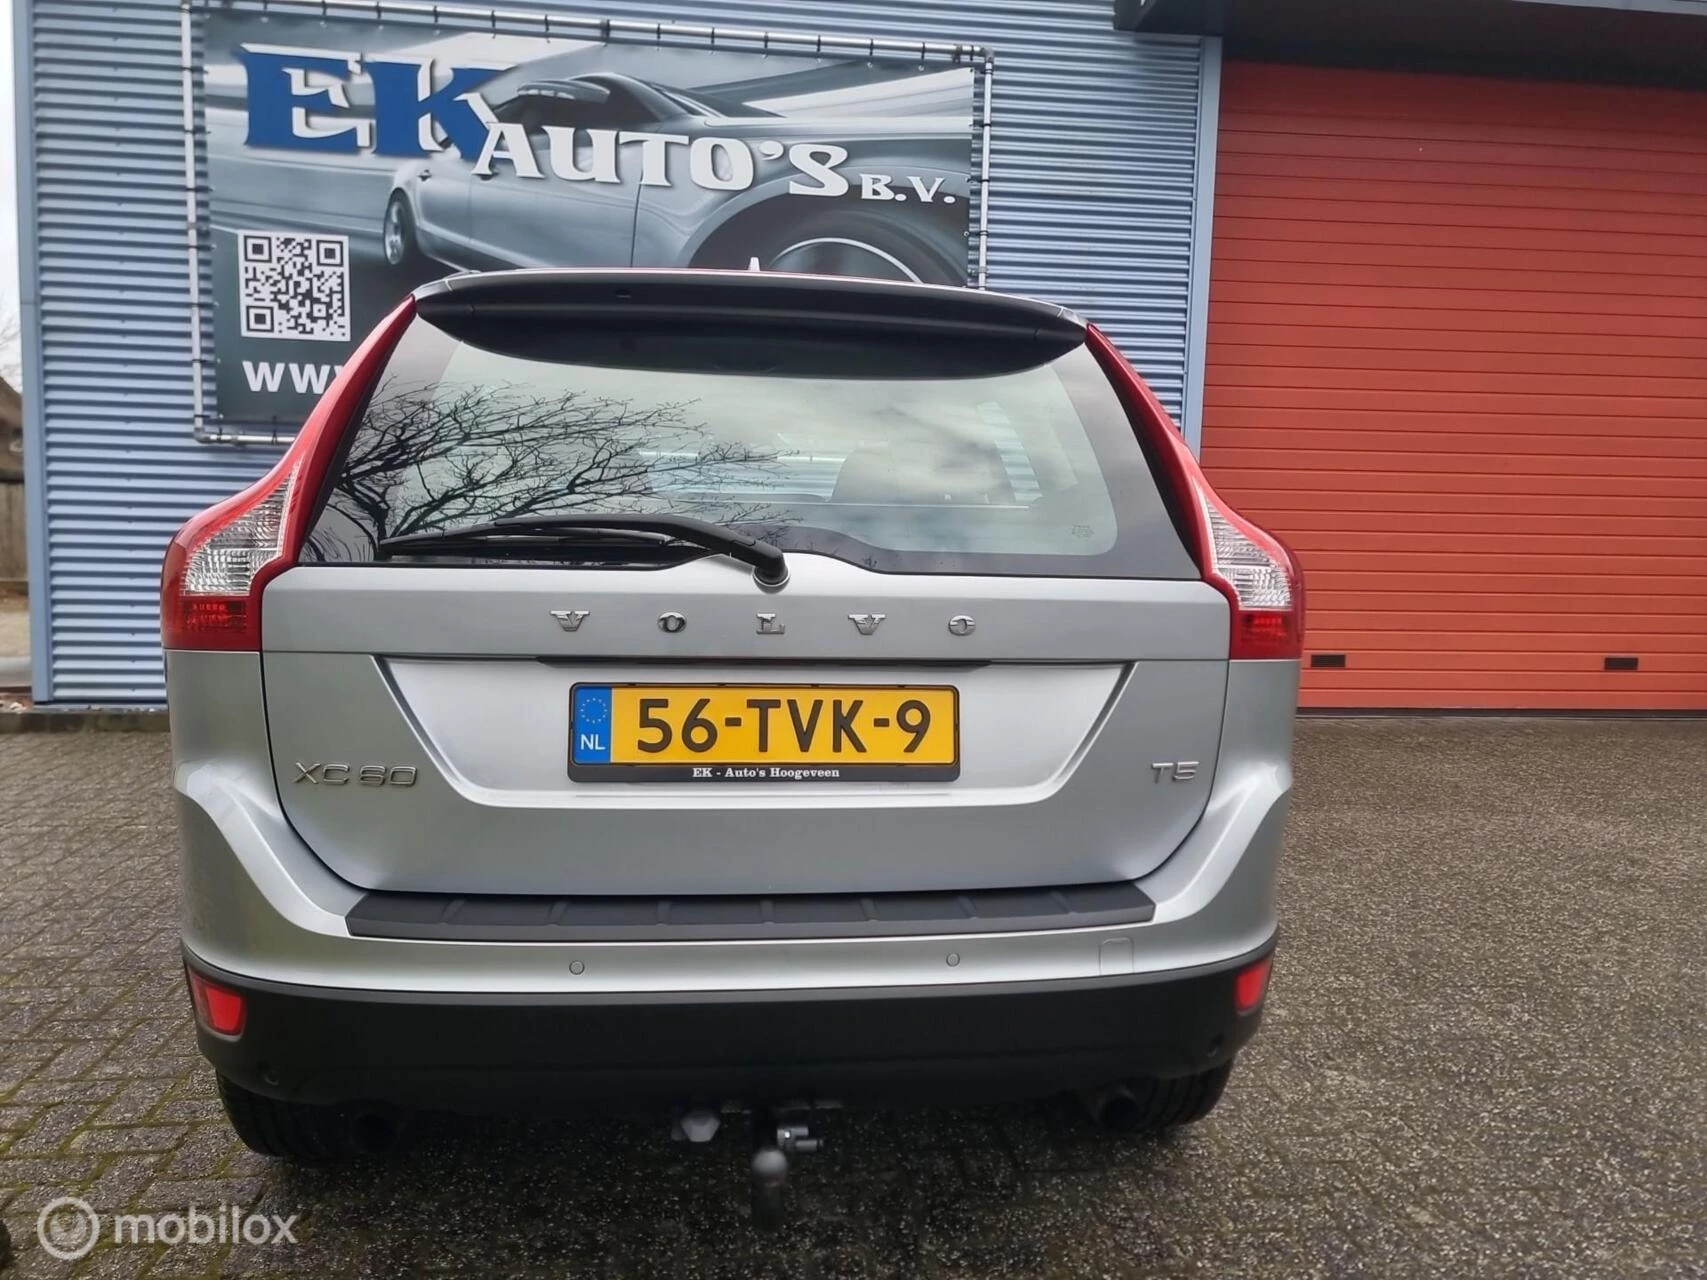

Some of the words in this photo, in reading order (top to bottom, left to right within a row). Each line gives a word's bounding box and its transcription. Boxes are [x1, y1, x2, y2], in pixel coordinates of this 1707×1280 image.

[234, 43, 518, 162] EK
[471, 122, 849, 198] AUTO'S
[858, 174, 957, 204] B.V.
[550, 609, 977, 637] VOLVO
[637, 697, 931, 754] 56-TVK-9
[580, 734, 606, 751] NL
[692, 767, 713, 778] EK
[724, 767, 766, 778] Auto's
[769, 767, 840, 780] Hoogeveen
[1151, 761, 1200, 784] T5
